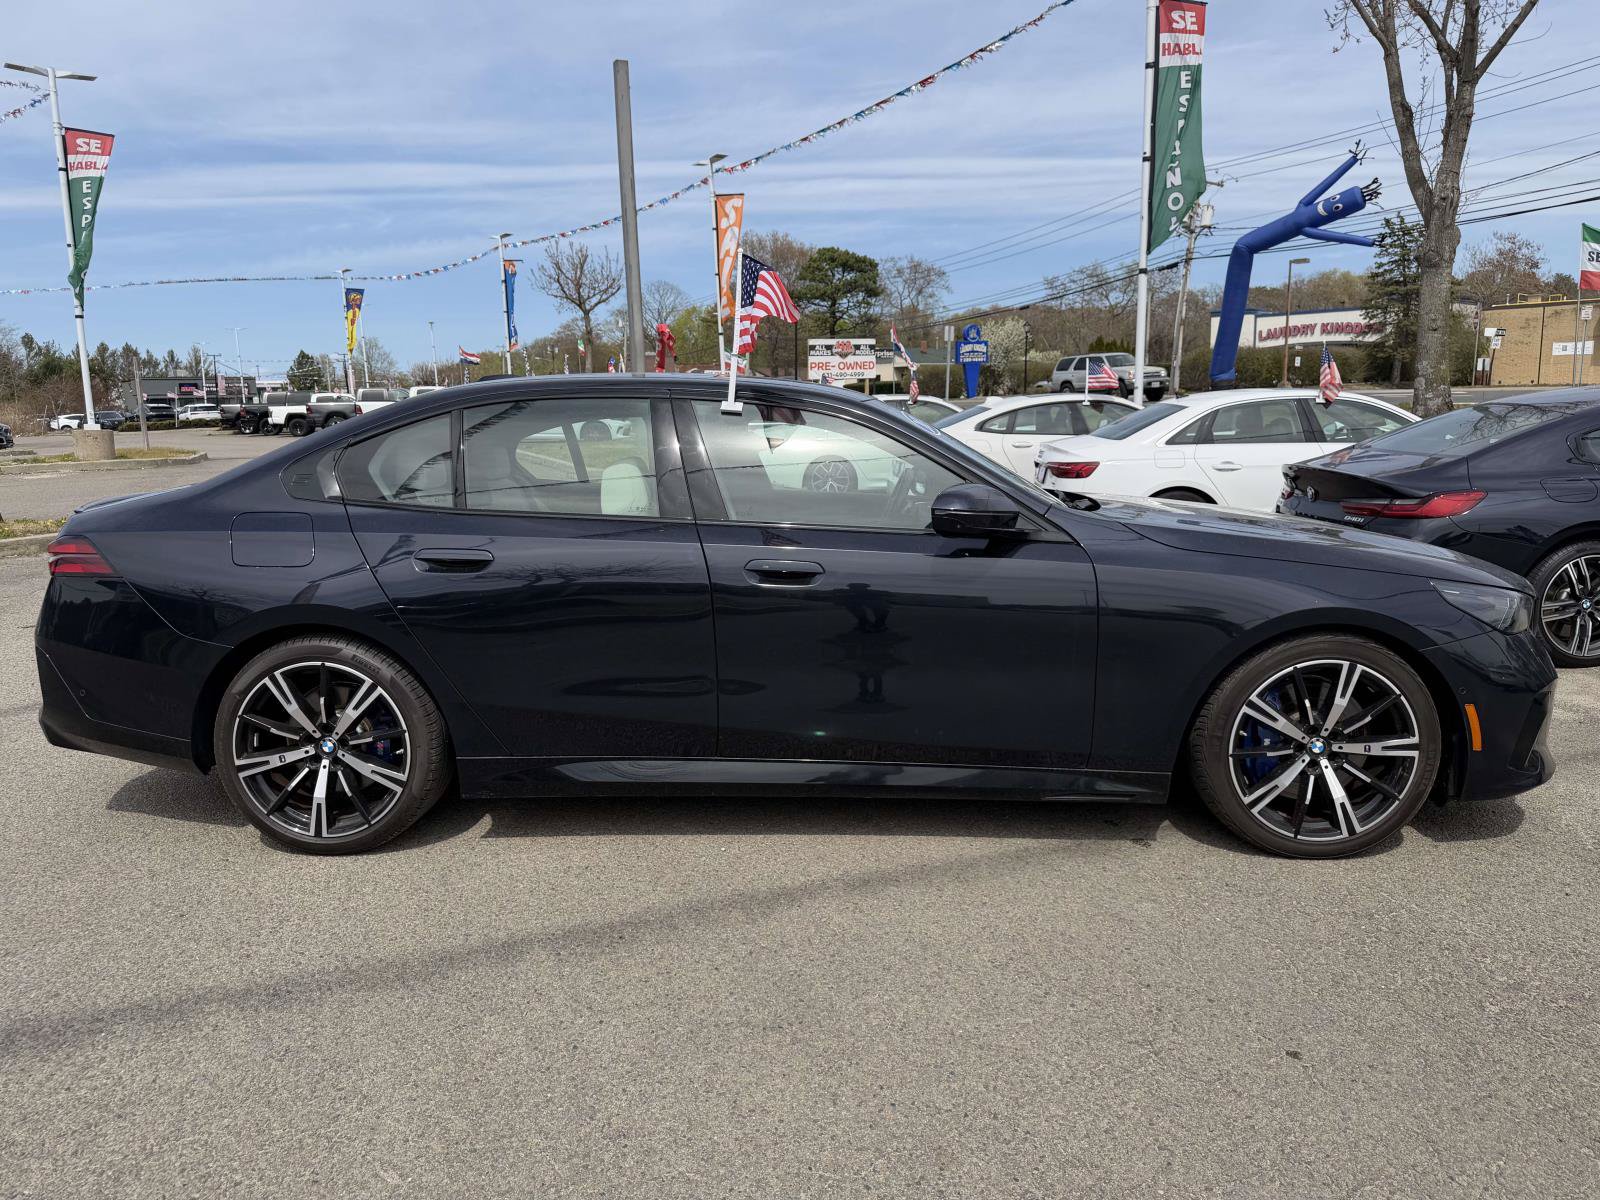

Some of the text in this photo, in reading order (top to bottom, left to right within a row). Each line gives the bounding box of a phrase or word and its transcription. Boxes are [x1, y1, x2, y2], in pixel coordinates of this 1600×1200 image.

[1171, 10, 1198, 31] SE
[1161, 42, 1202, 57] HABL
[75, 137, 102, 153] SE
[1258, 322, 1385, 342] LAUNDRY KINGDO
[810, 361, 875, 371] PRE- OWNED
